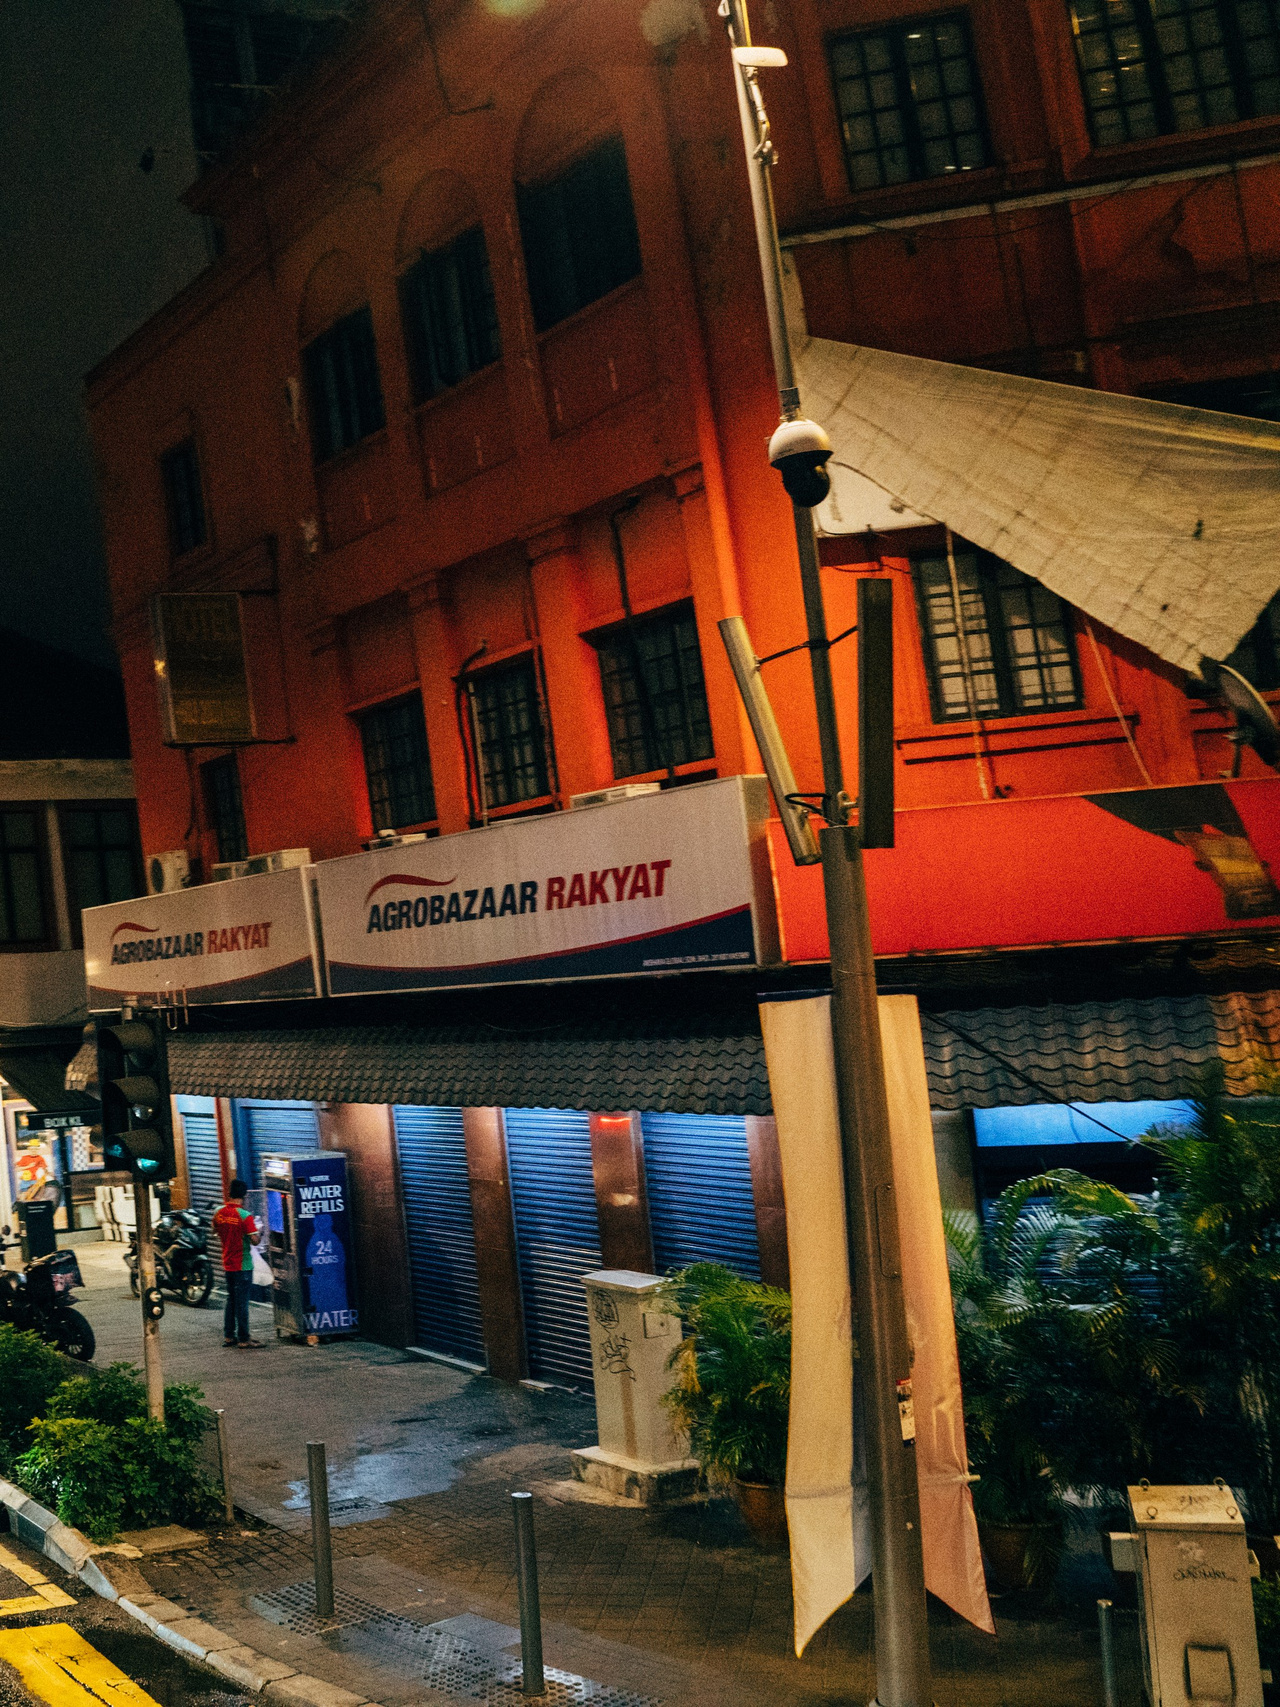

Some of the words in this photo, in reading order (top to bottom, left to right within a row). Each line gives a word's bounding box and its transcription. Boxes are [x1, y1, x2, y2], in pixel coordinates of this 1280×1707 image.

[366, 880, 538, 933] AGROBAZAAR
[545, 859, 672, 911] RAKYAT
[111, 932, 204, 965] AGROBAZAAR
[207, 922, 272, 954] RAKYAT
[299, 1185, 342, 1200] WATER
[301, 1200, 344, 1214] REFILLS
[315, 1240, 333, 1255] 24
[311, 1255, 339, 1265] HOURS
[304, 1309, 359, 1329] WATER
